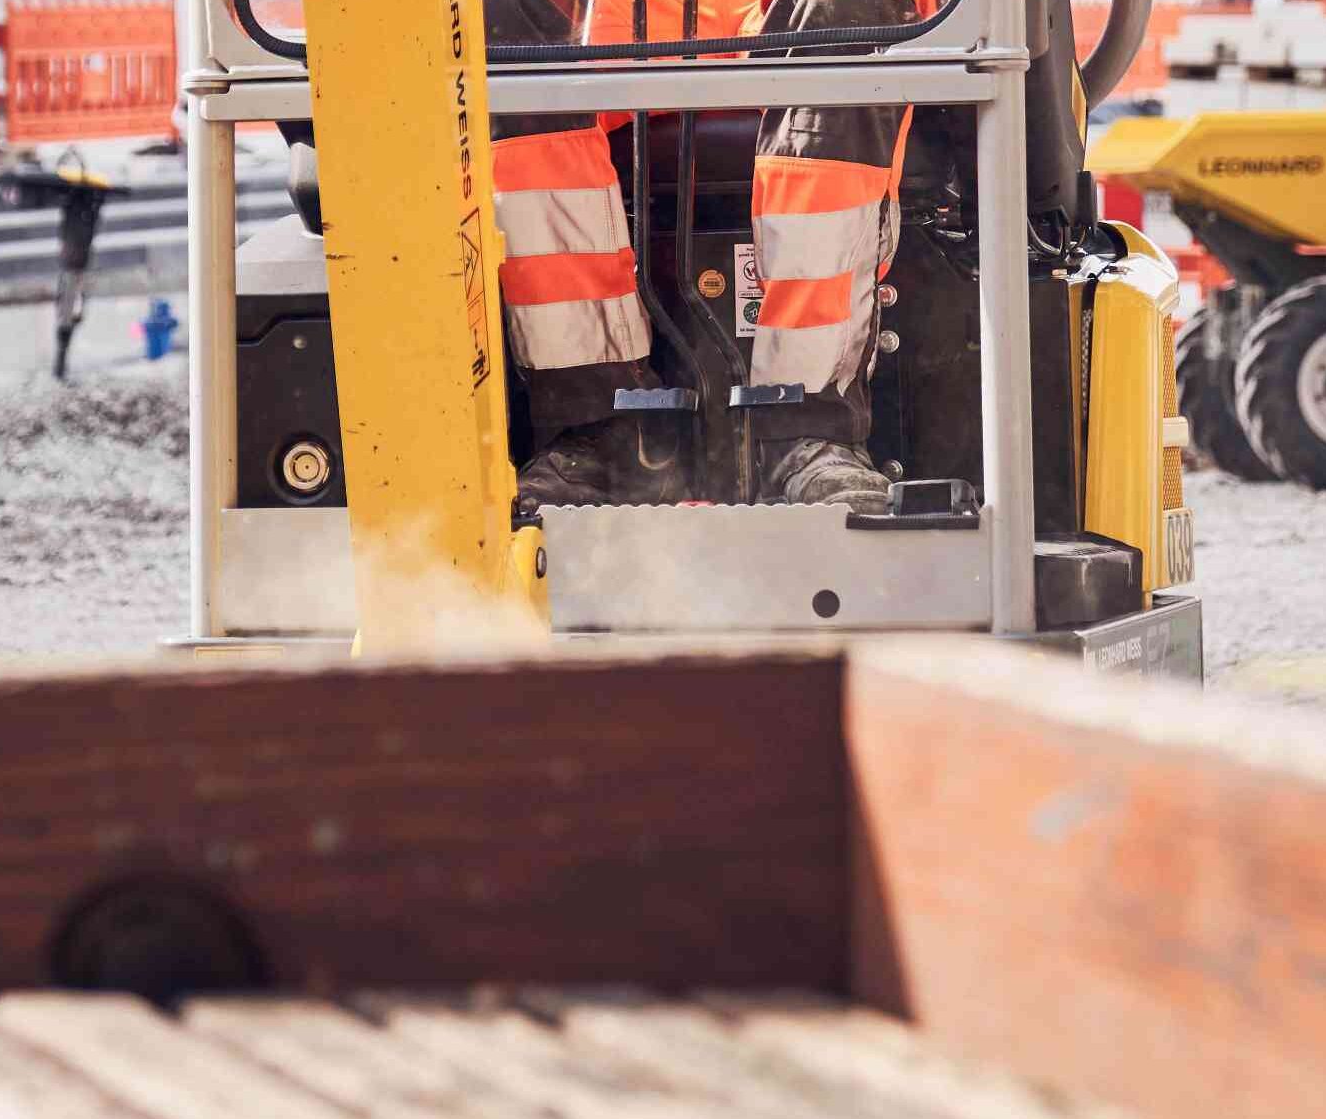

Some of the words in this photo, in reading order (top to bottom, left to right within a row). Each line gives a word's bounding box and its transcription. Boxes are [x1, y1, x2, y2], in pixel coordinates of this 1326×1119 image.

[454, 70, 473, 203] WEISS
[1198, 156, 1323, 176] LEONHARD
[1167, 513, 1195, 585] 039
